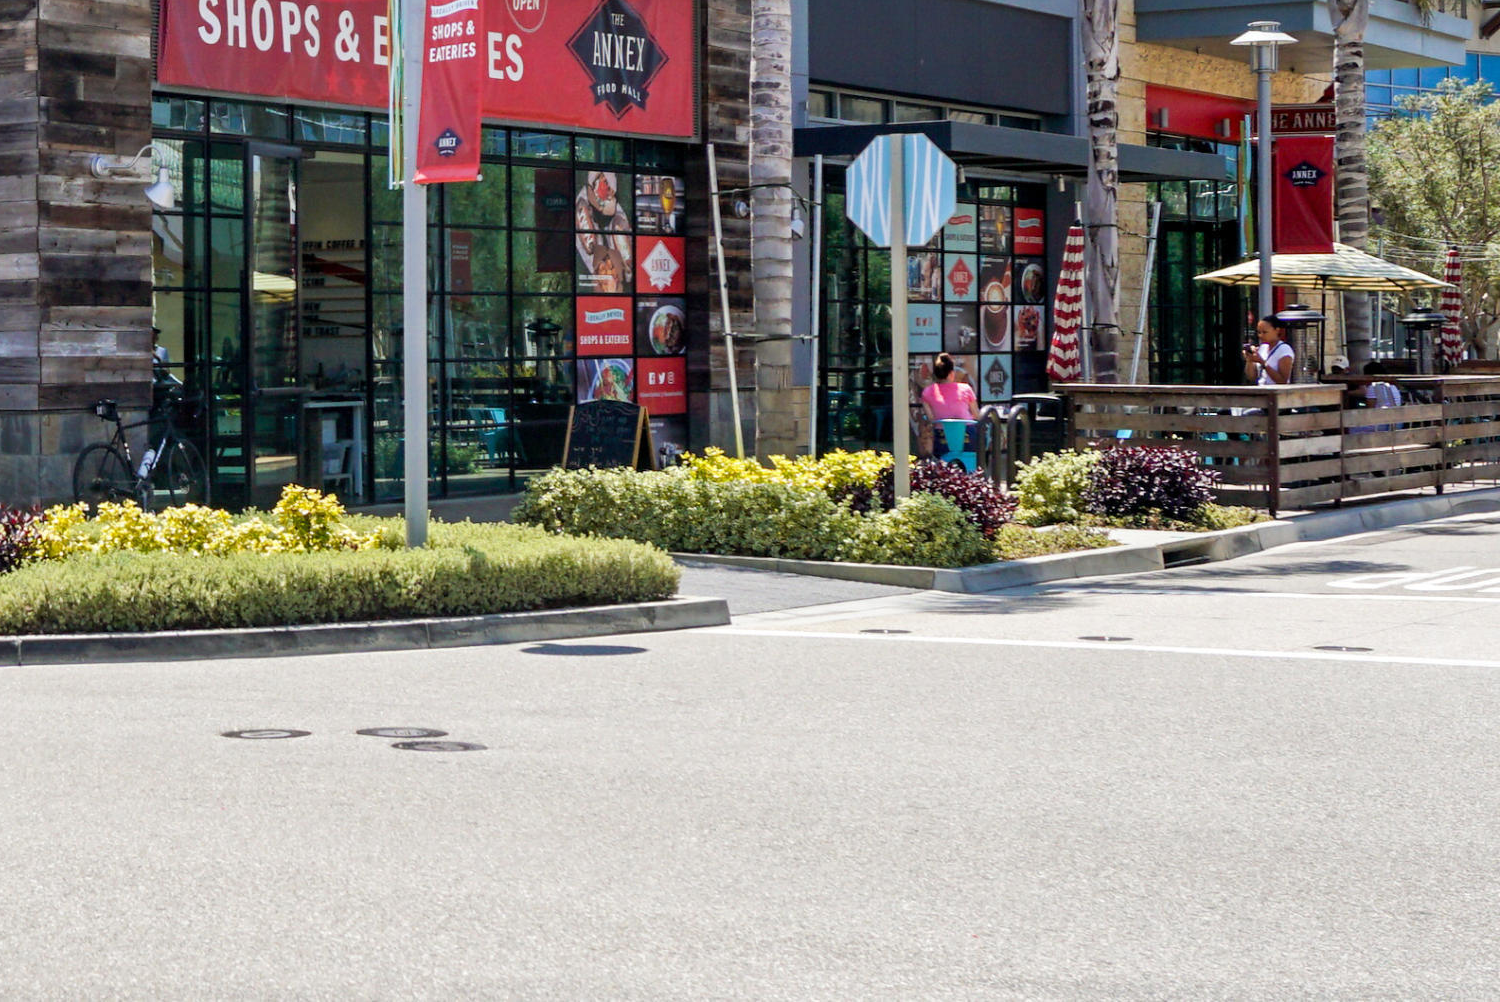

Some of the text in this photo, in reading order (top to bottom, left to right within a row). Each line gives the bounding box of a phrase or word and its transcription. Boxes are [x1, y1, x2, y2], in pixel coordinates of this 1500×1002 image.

[611, 13, 625, 26] THE
[336, 9, 361, 63] &
[432, 20, 475, 41] SHOPS &
[429, 42, 477, 63] EATERIES
[592, 31, 646, 72] ANNEX
[597, 83, 642, 101] FOOD HALL
[1271, 112, 1336, 129] HE ANNE
[438, 137, 457, 148] ANNEX
[1292, 170, 1317, 179] ANNEX
[326, 240, 356, 248] COFFEE
[580, 334, 598, 345] SHOPS
[605, 334, 630, 344] EATERIES
